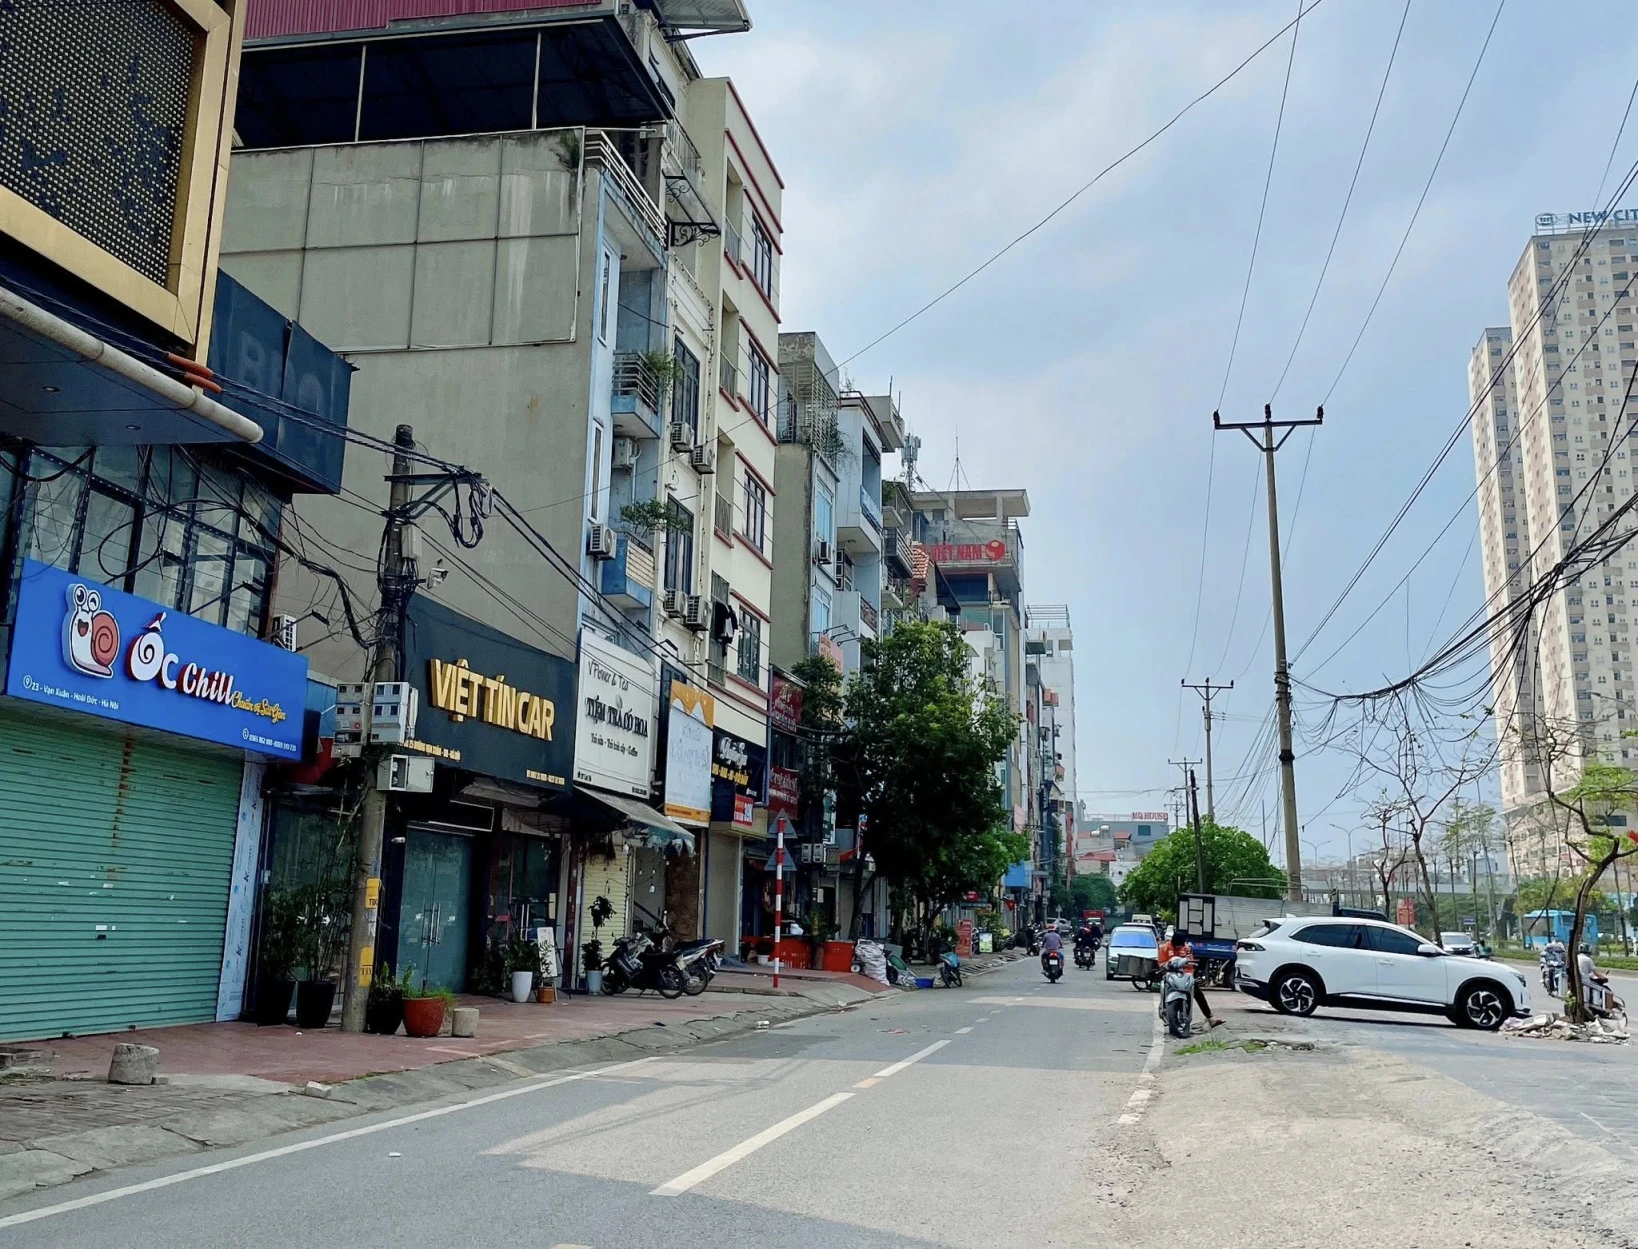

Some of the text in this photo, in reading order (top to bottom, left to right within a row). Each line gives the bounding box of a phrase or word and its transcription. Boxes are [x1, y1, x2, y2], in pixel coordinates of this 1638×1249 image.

[1569, 210, 1608, 224] NEW
[31, 682, 39, 692] 23
[43, 684, 55, 696] Vạn
[182, 662, 234, 705] Chill
[431, 658, 555, 741] VIỆT TÍN CAR
